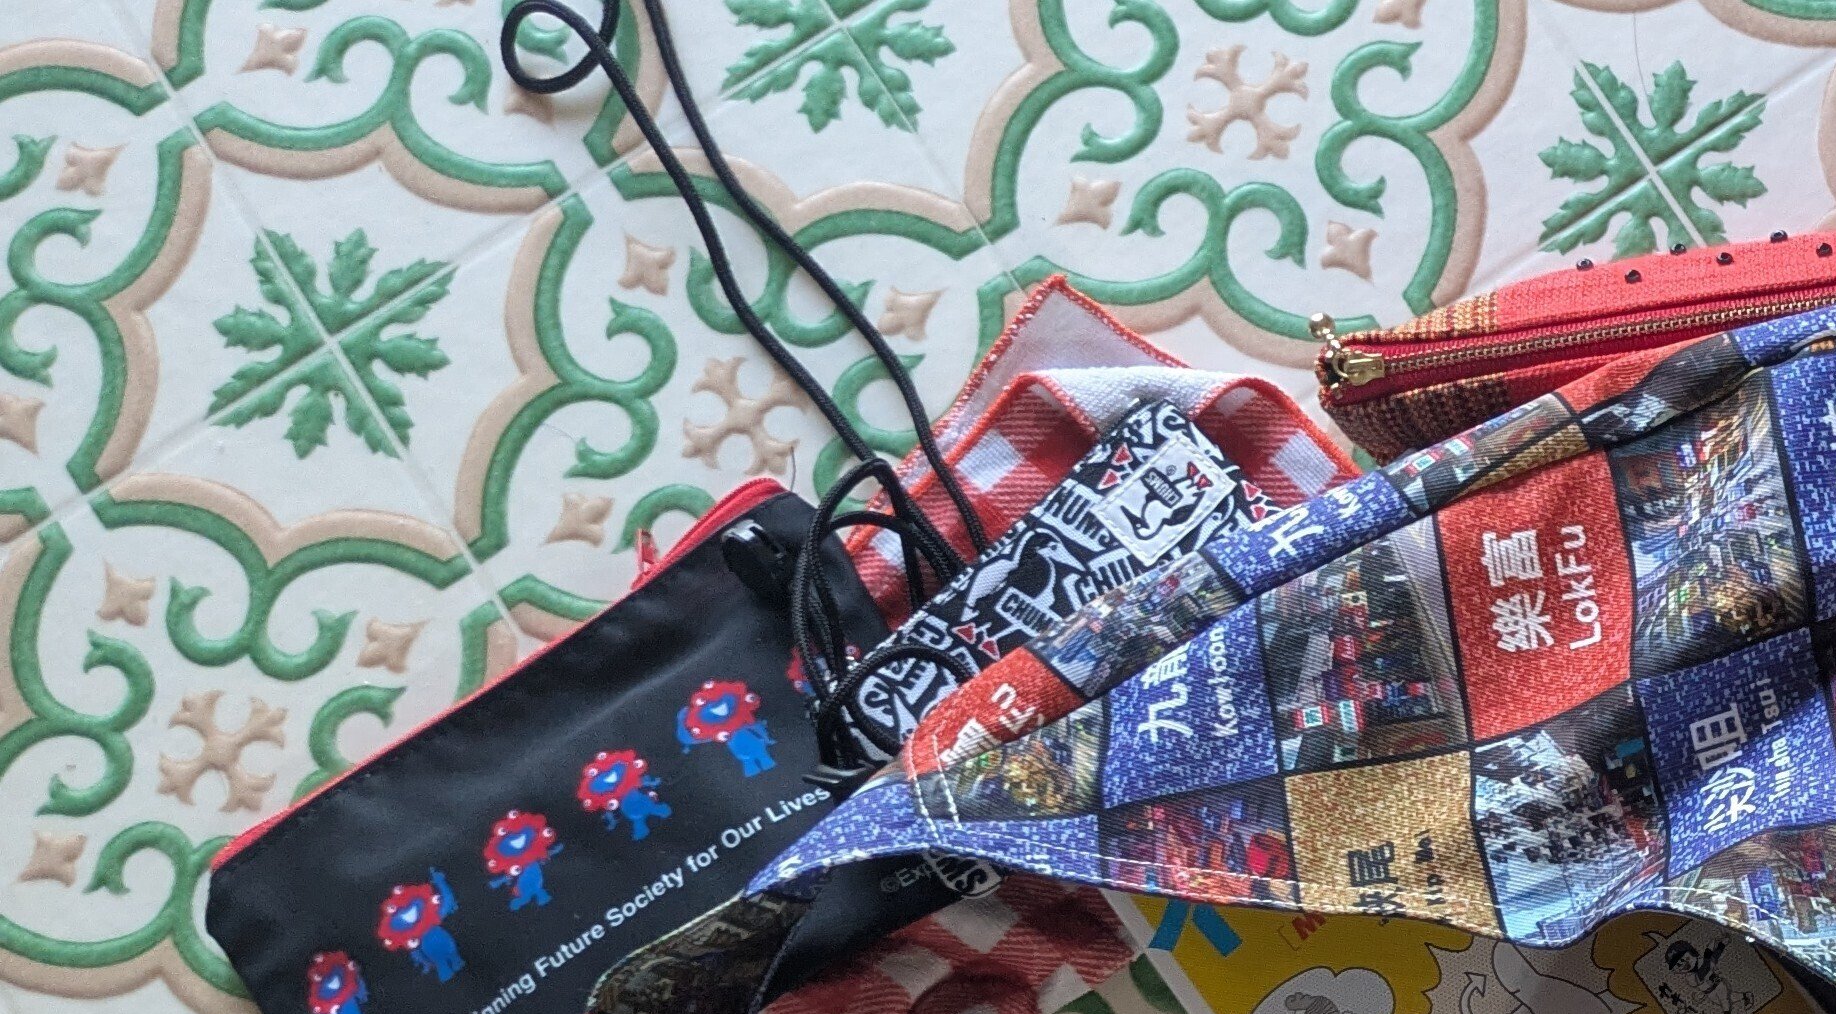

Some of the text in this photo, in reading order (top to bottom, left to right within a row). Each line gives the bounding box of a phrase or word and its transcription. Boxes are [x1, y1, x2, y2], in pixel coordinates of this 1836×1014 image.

[1146, 474, 1178, 506] CHUMS
[1001, 593, 1056, 635] CHUM
[1481, 528, 1554, 652] 樂富
[1554, 524, 1602, 649] LokFu
[1687, 702, 1757, 834] 尖沙咀
[1750, 678, 1784, 735] Tsui
[534, 922, 606, 979] Future
[605, 867, 685, 929] Society
[687, 843, 720, 874] for
[719, 817, 762, 850] Our
[765, 787, 831, 823] Lives
